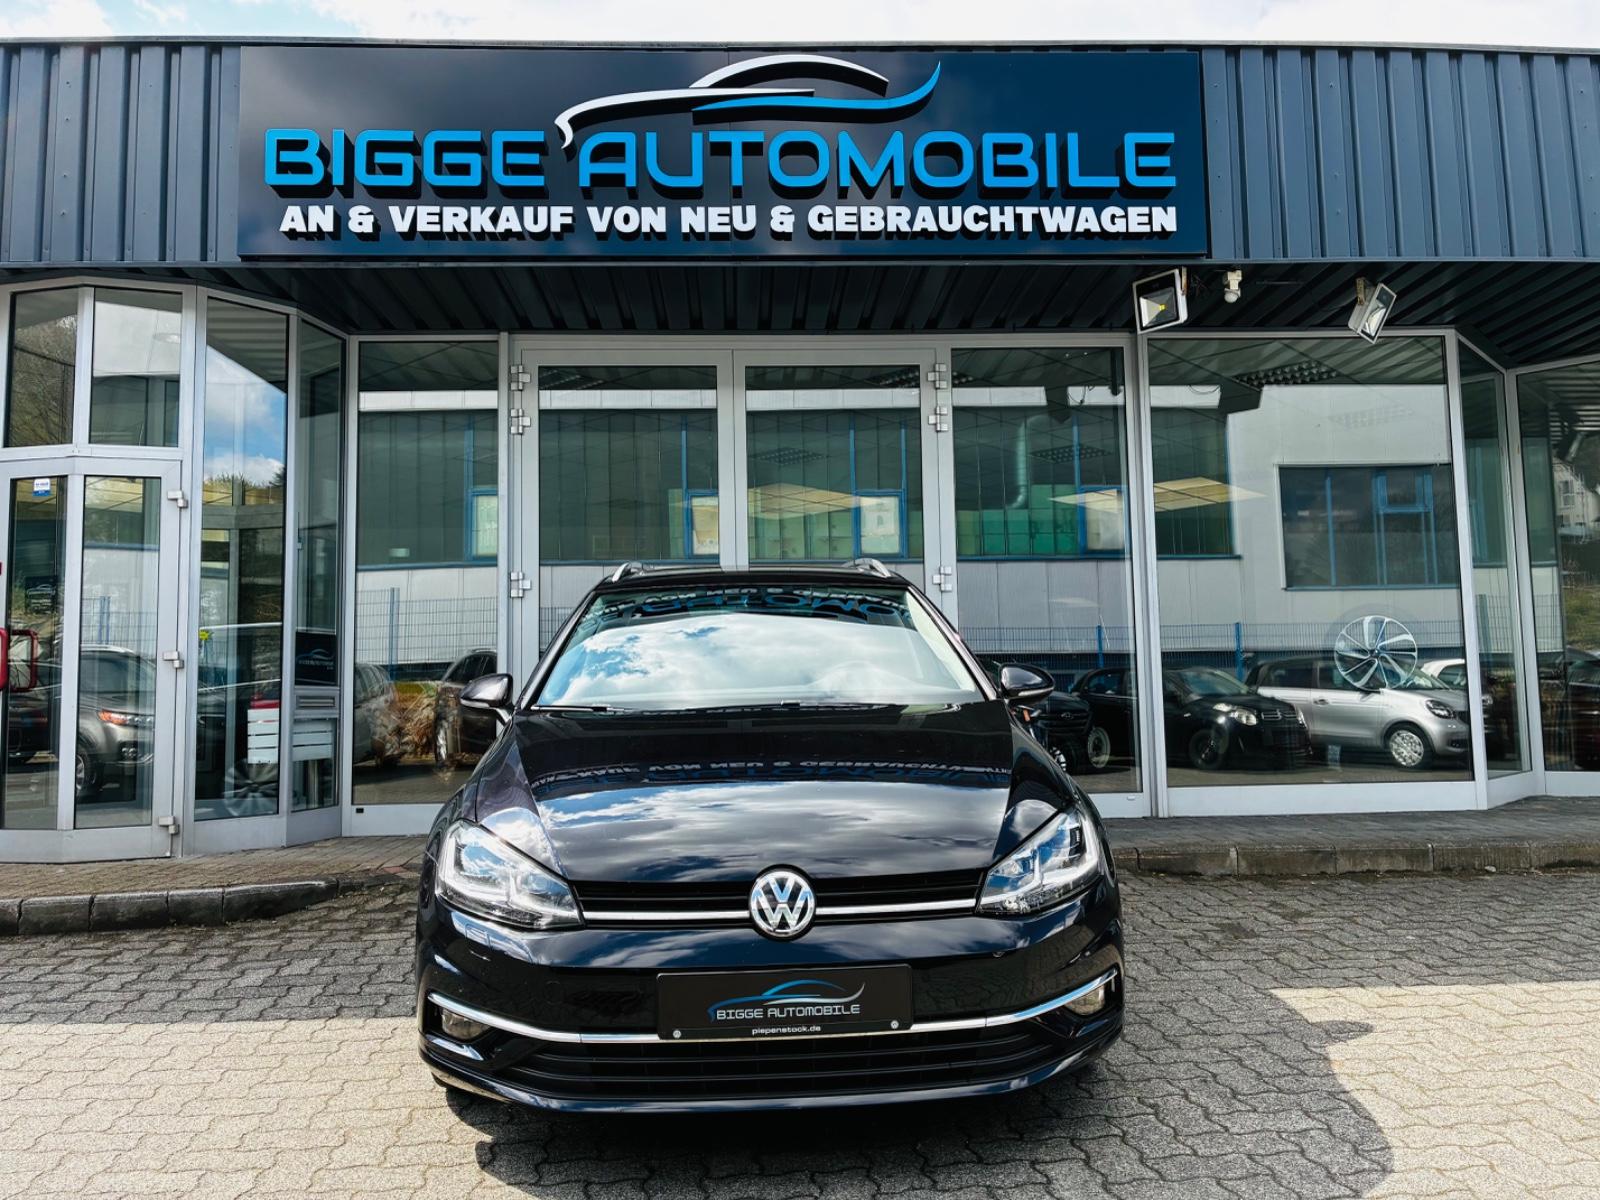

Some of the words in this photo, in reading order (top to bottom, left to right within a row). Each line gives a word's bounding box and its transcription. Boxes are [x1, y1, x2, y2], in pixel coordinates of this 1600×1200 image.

[264, 128, 545, 187] BIGGE
[579, 130, 1177, 188] AUTOMOBILE
[279, 205, 334, 233] AN
[348, 205, 375, 233] &
[389, 205, 574, 233] VERKAUF
[587, 205, 667, 233] VON
[681, 205, 758, 233] NEU
[770, 205, 796, 233] &
[807, 205, 1177, 233] GEBRAUCHTWAGEN
[716, 1008, 763, 1020] BIGGE
[767, 1004, 861, 1018] AUTOMOBILE
[752, 1024, 822, 1036] piepenstock.de
